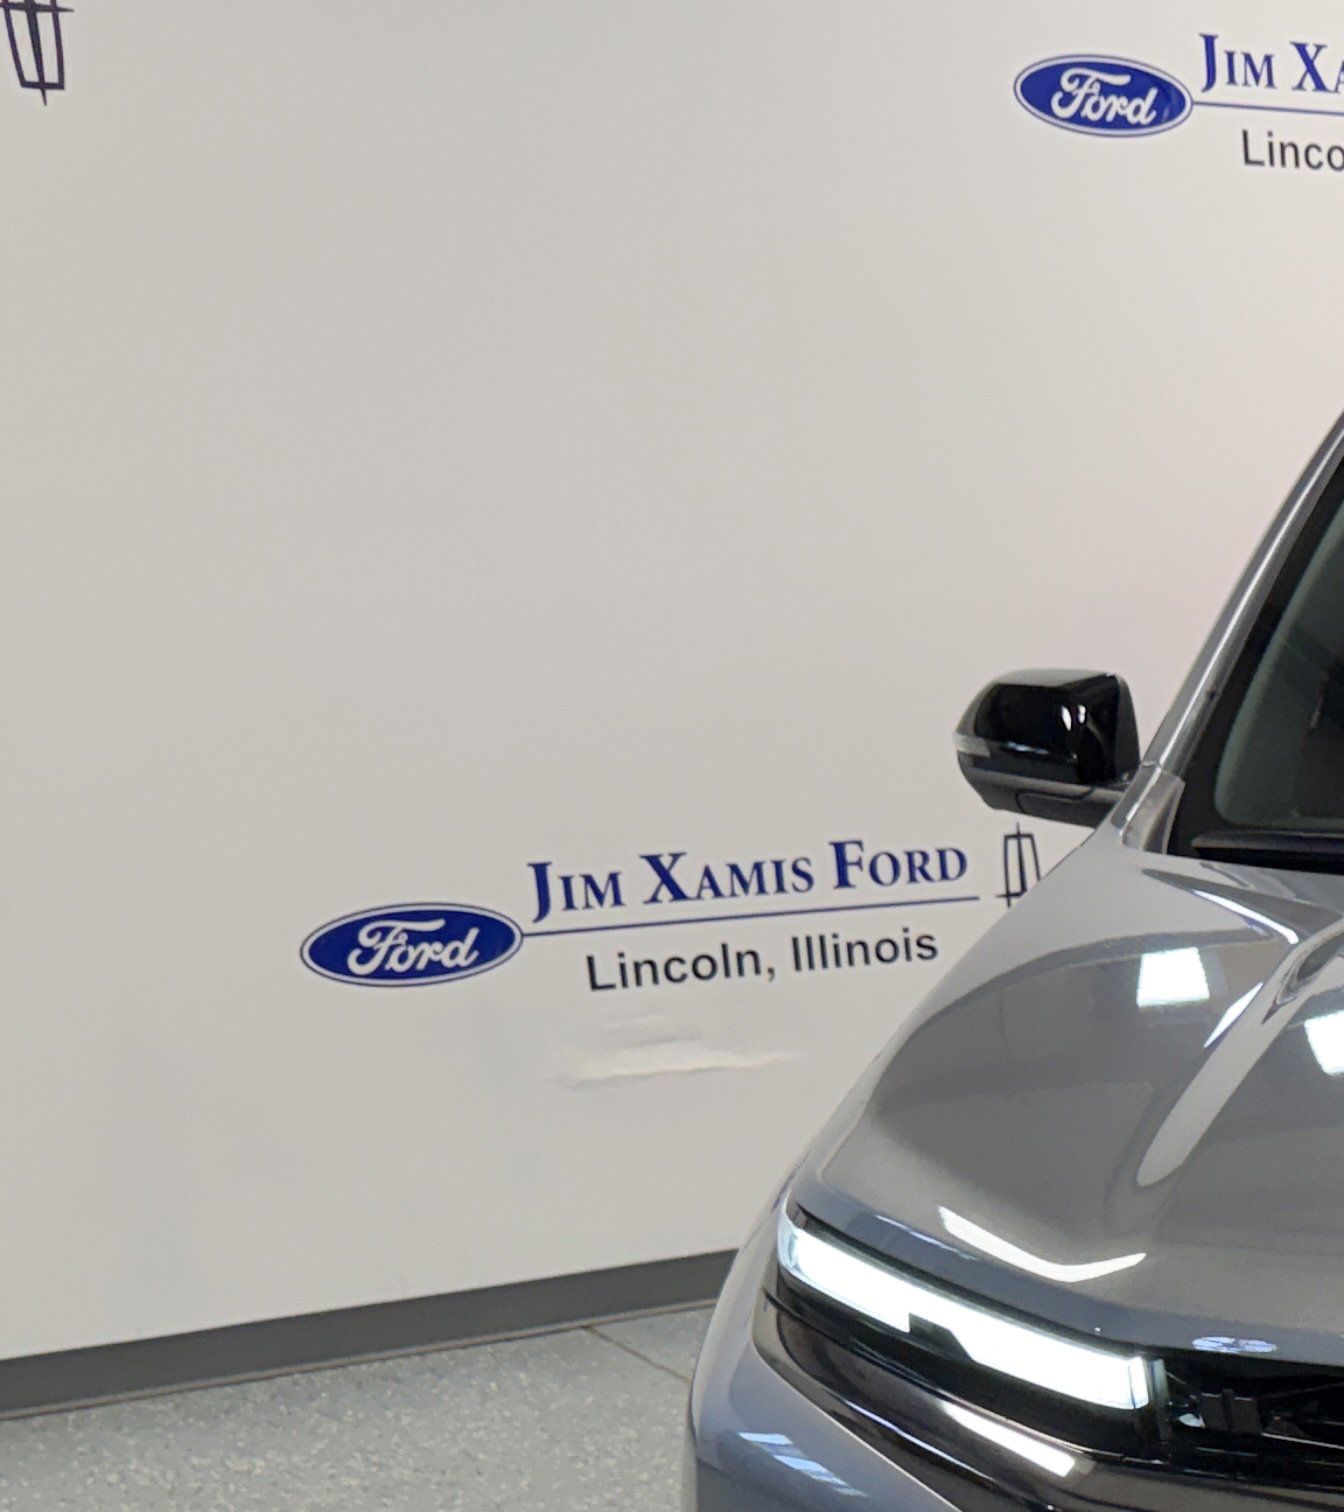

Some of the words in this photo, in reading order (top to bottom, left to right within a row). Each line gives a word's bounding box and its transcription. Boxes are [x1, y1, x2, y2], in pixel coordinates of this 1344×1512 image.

[1199, 33, 1275, 94] JIM
[1052, 68, 1157, 126] Ford
[525, 860, 626, 923] JIM
[639, 852, 815, 904] XAMIS
[828, 840, 969, 890] FORD
[346, 919, 479, 975] Ford
[586, 943, 776, 992] Lincoln,
[791, 927, 939, 974] Illinois
